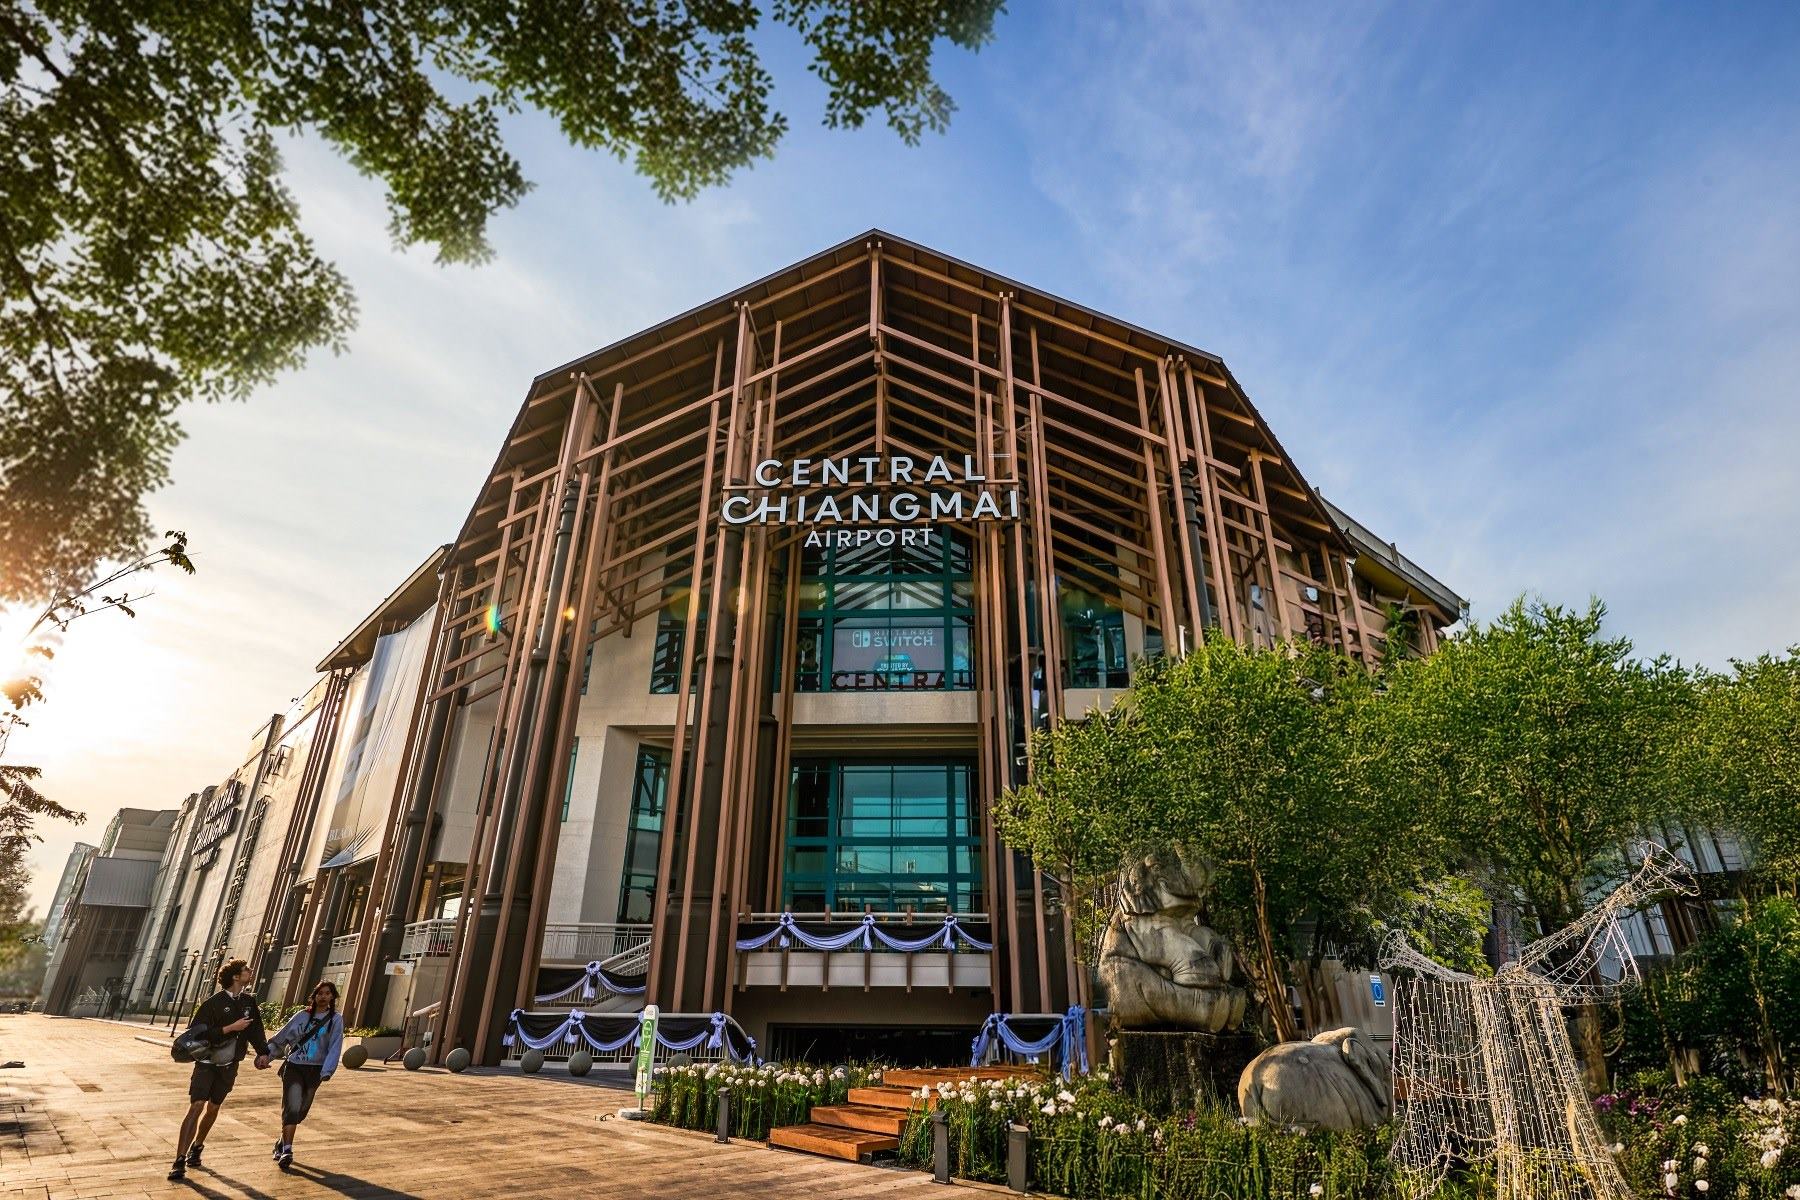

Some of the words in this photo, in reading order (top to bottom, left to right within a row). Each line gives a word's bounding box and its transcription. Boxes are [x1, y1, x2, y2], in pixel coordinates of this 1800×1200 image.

[755, 454, 986, 487] CENTRAL
[722, 490, 1018, 524] CHIANGMAI
[804, 528, 934, 548] AIRPORT
[874, 636, 933, 647] SWITCH
